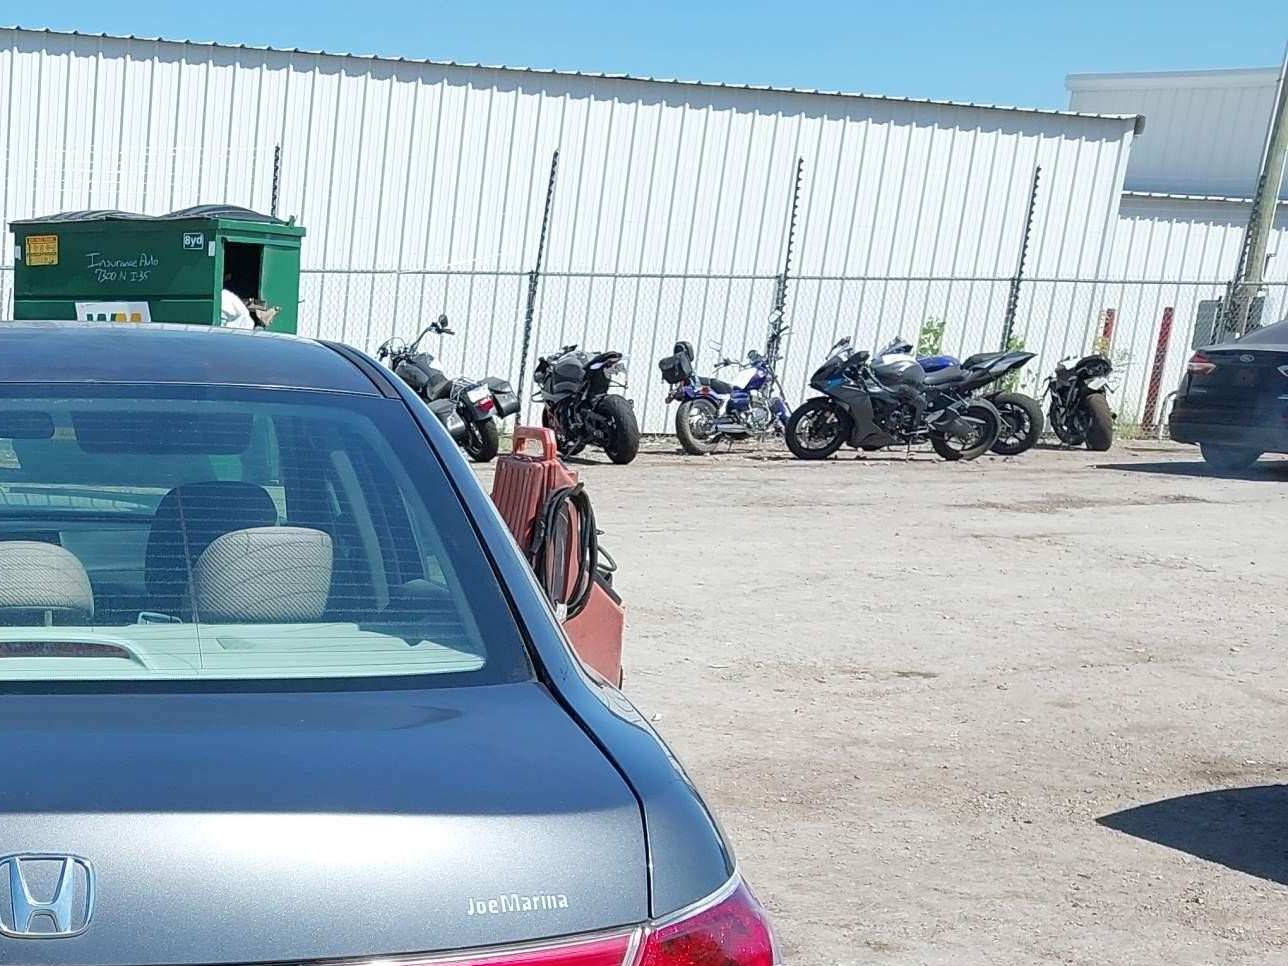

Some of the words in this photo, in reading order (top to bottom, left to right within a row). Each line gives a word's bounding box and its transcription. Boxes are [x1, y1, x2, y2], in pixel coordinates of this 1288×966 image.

[184, 235, 202, 248] 8yd
[85, 252, 138, 269] Insurance
[467, 891, 569, 916] JoeMarina
